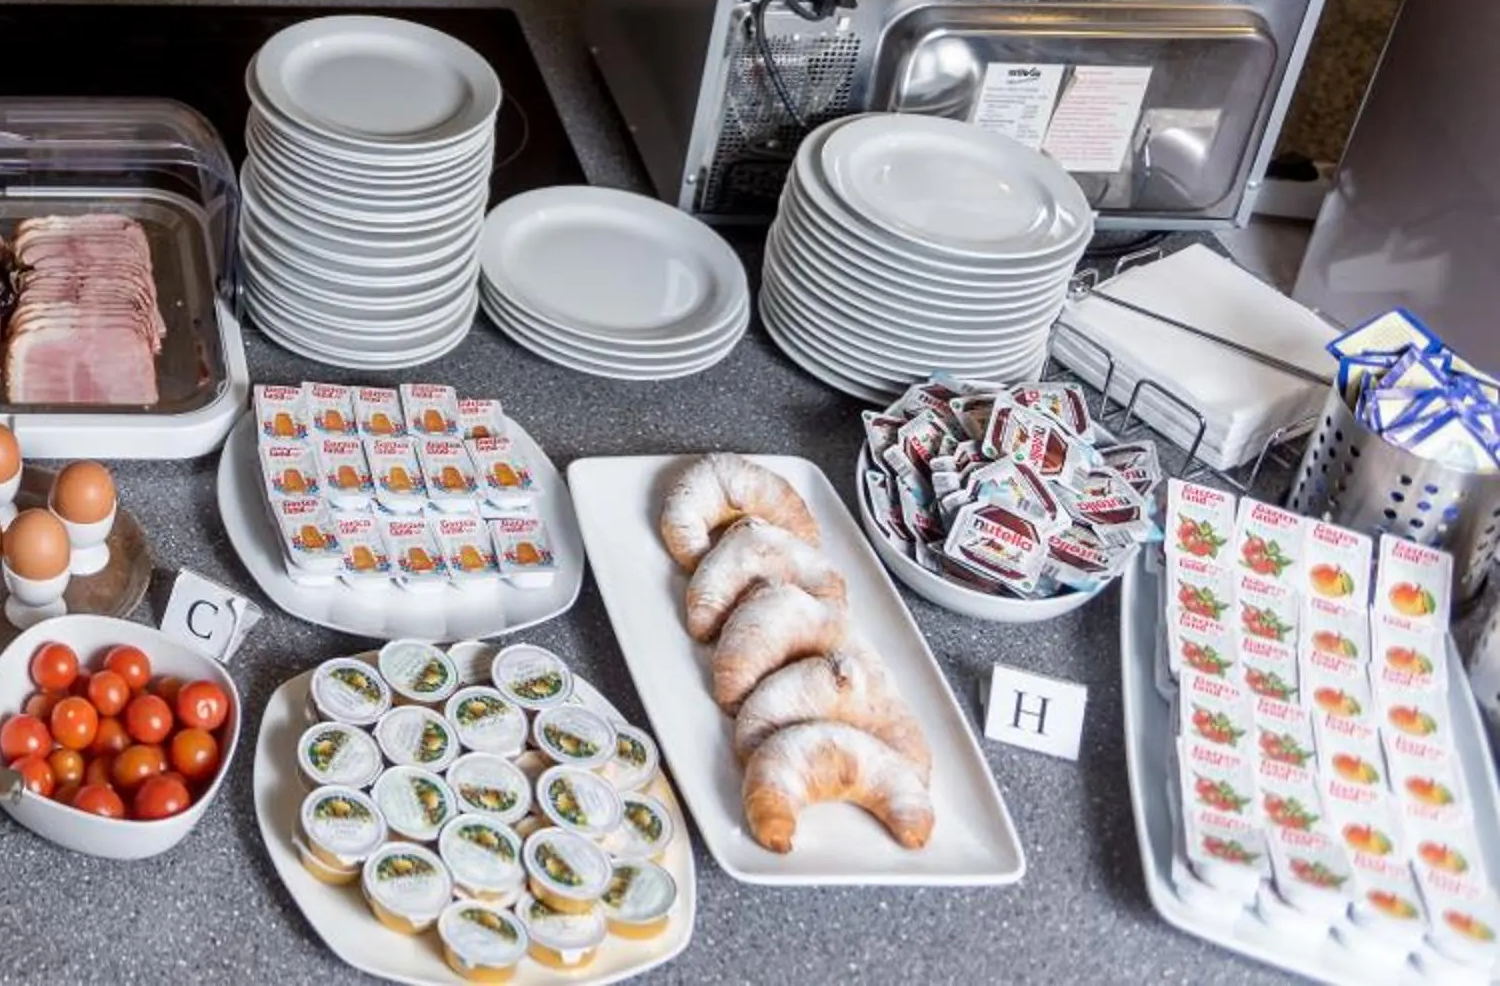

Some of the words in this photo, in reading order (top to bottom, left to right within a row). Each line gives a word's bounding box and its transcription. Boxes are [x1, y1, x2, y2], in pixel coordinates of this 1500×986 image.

[973, 517, 1034, 553] nutella
[186, 599, 219, 641] C
[1008, 688, 1053, 737] H
